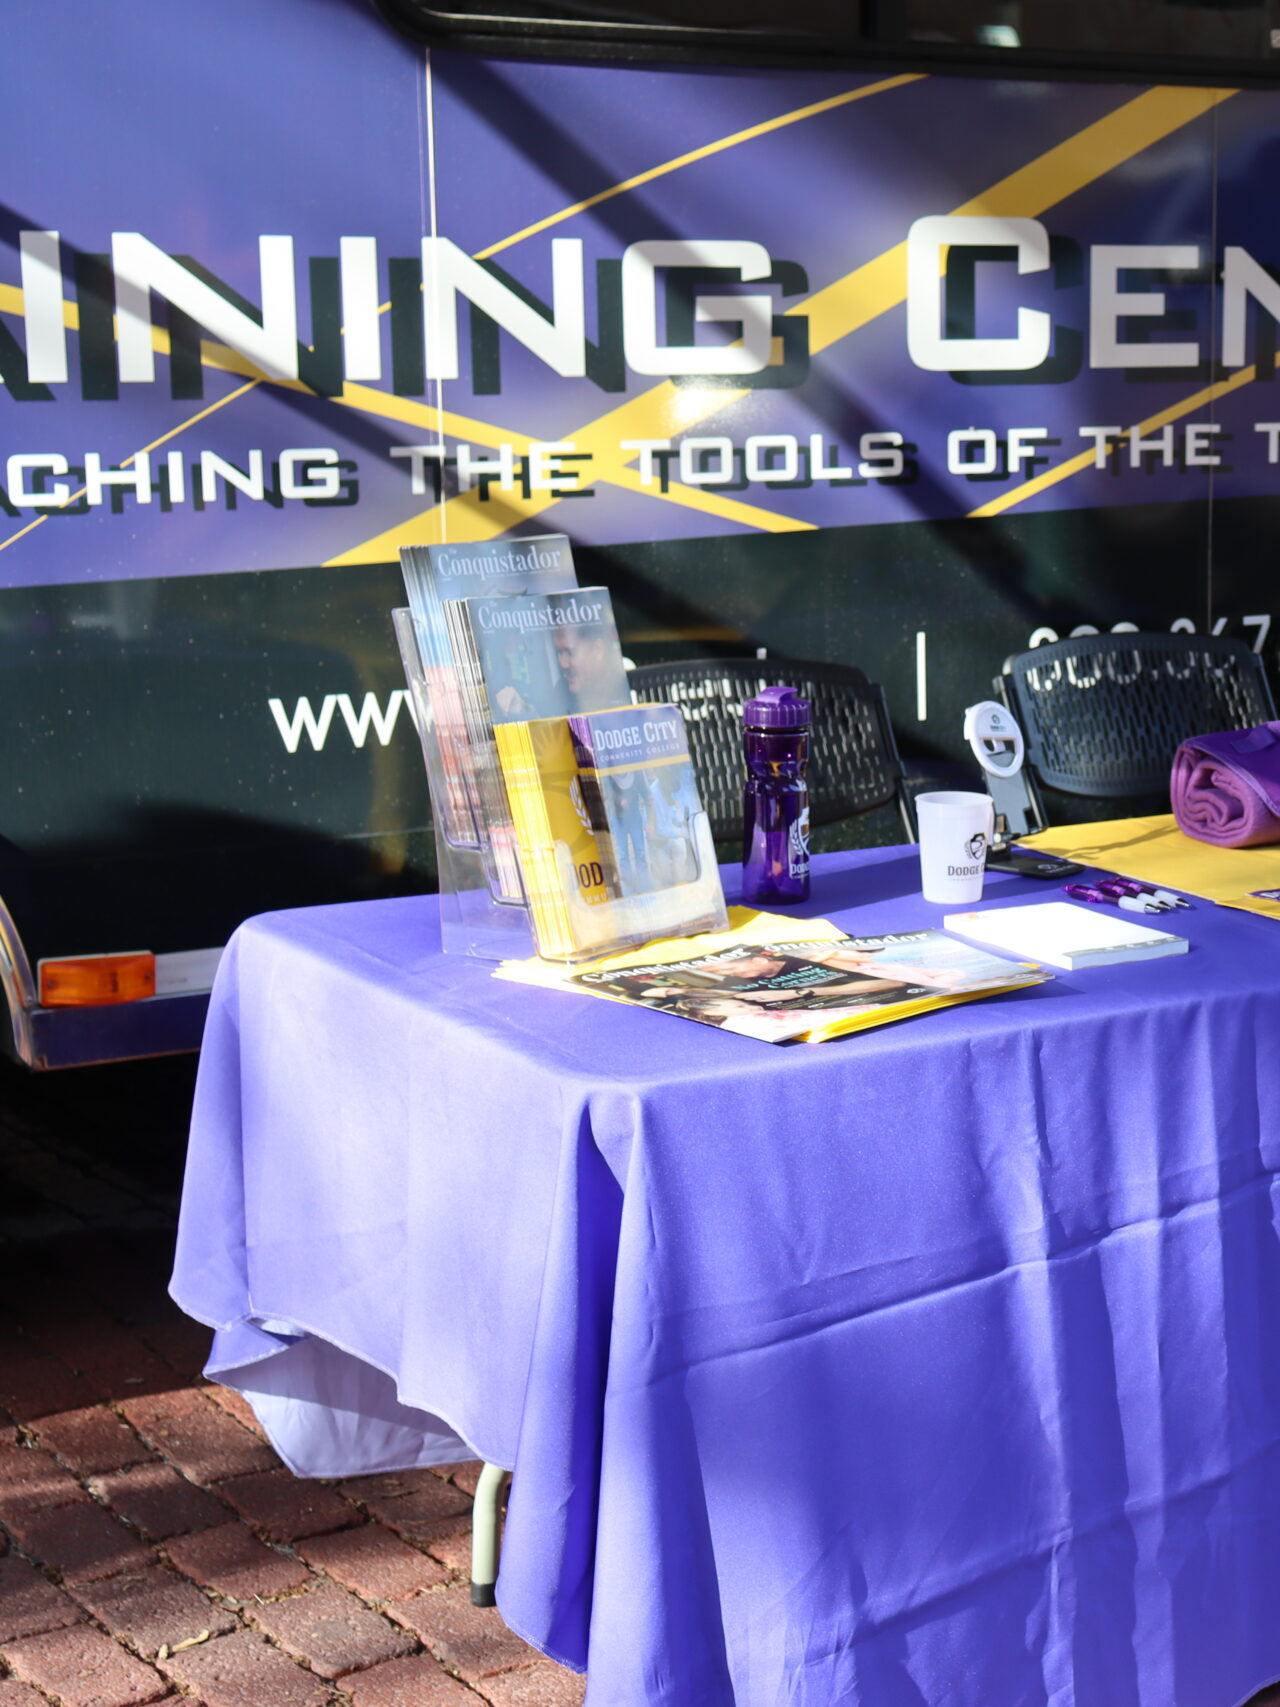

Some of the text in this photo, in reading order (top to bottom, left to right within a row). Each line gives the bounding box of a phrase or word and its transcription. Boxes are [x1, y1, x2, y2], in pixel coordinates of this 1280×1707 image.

[390, 440, 578, 496] THE
[621, 431, 904, 487] TOOLS
[947, 427, 1048, 475] OF
[1079, 423, 1221, 469] THE
[437, 545, 561, 580] Conquistador
[478, 598, 603, 634] Conquistador
[593, 720, 678, 752] DODGE CITY
[599, 743, 680, 763] COMMUNITY COLLEGE
[947, 863, 981, 877] DODGE
[762, 930, 929, 953] onquistador
[582, 945, 751, 985] Conquistador
